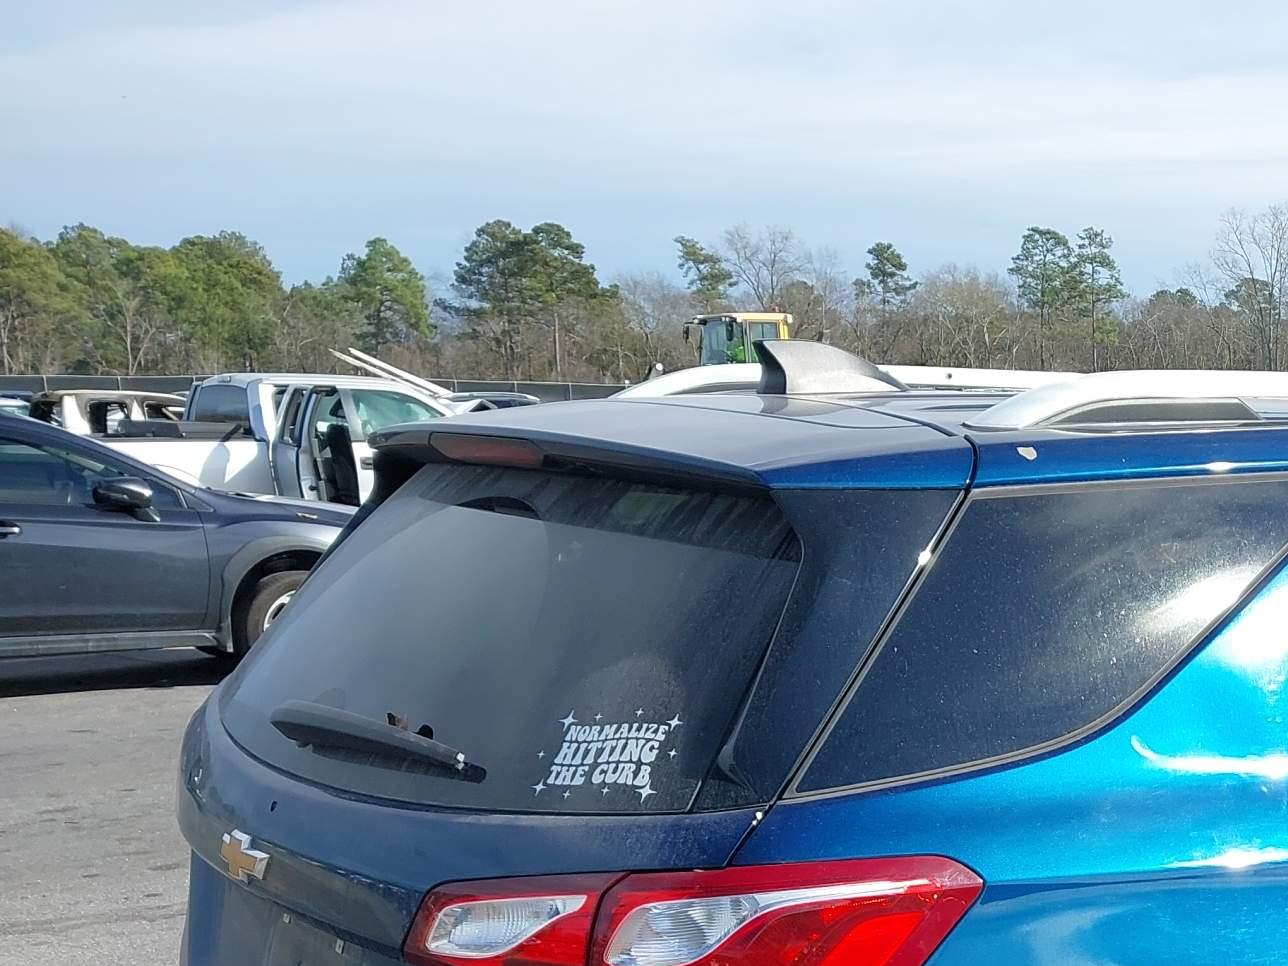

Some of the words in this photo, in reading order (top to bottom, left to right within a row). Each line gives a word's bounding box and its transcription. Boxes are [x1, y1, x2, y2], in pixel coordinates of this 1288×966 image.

[564, 723, 669, 742] NORMALIZE
[553, 739, 660, 765] HITTING
[546, 764, 589, 786] THE
[591, 763, 652, 786] CURB
